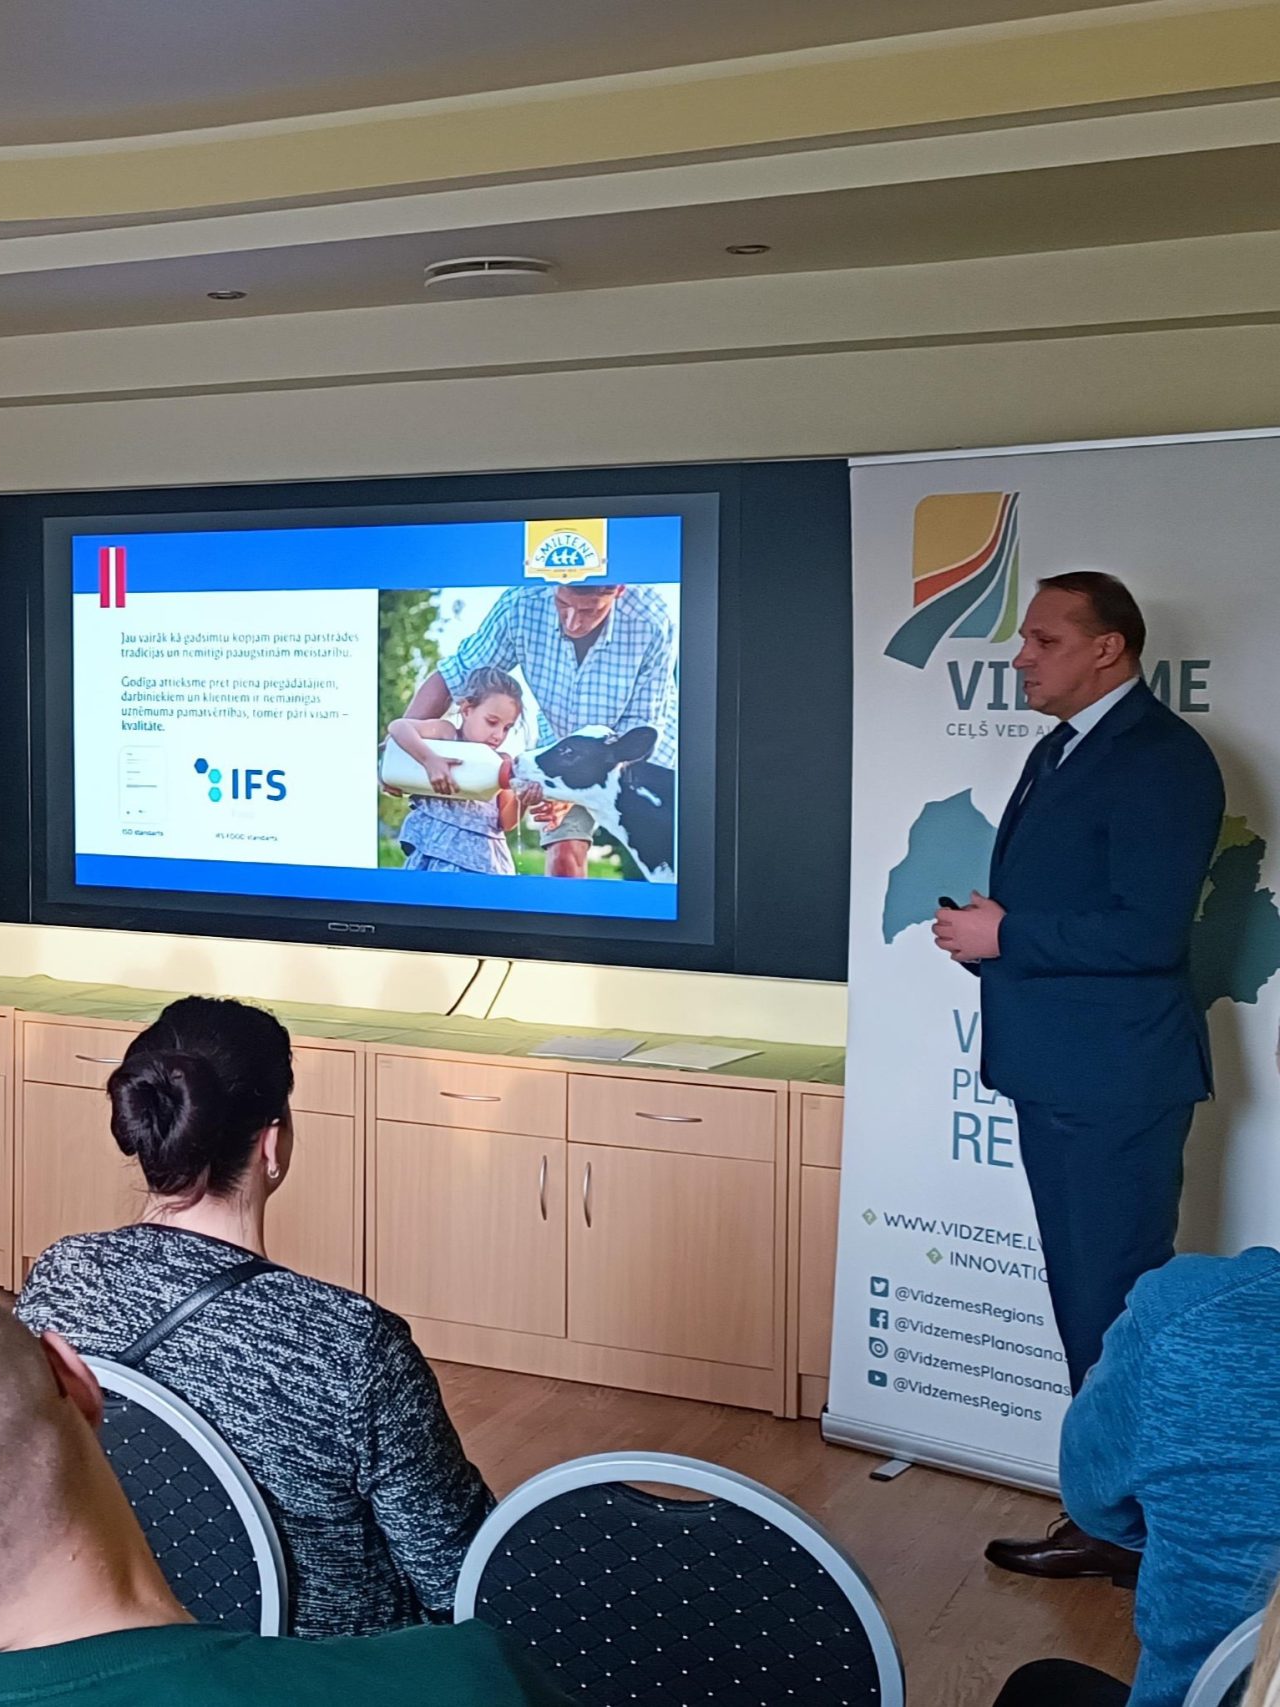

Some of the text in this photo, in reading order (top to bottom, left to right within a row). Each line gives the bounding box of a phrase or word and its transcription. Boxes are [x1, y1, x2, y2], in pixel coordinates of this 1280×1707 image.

[121, 632, 137, 644] Jau
[139, 632, 168, 643] vairāk
[184, 632, 230, 645] gadsimtu
[167, 650, 180, 658] un
[121, 691, 185, 702] darbiniekiem
[187, 694, 200, 703] un
[947, 660, 1211, 713] VIME
[946, 720, 989, 739] CEĻŠ
[996, 724, 1029, 737] VED
[232, 769, 287, 801] IFS
[895, 1286, 1045, 1326] @VidzemesRegions
[893, 1377, 1043, 1421] @VidzemesRegions
